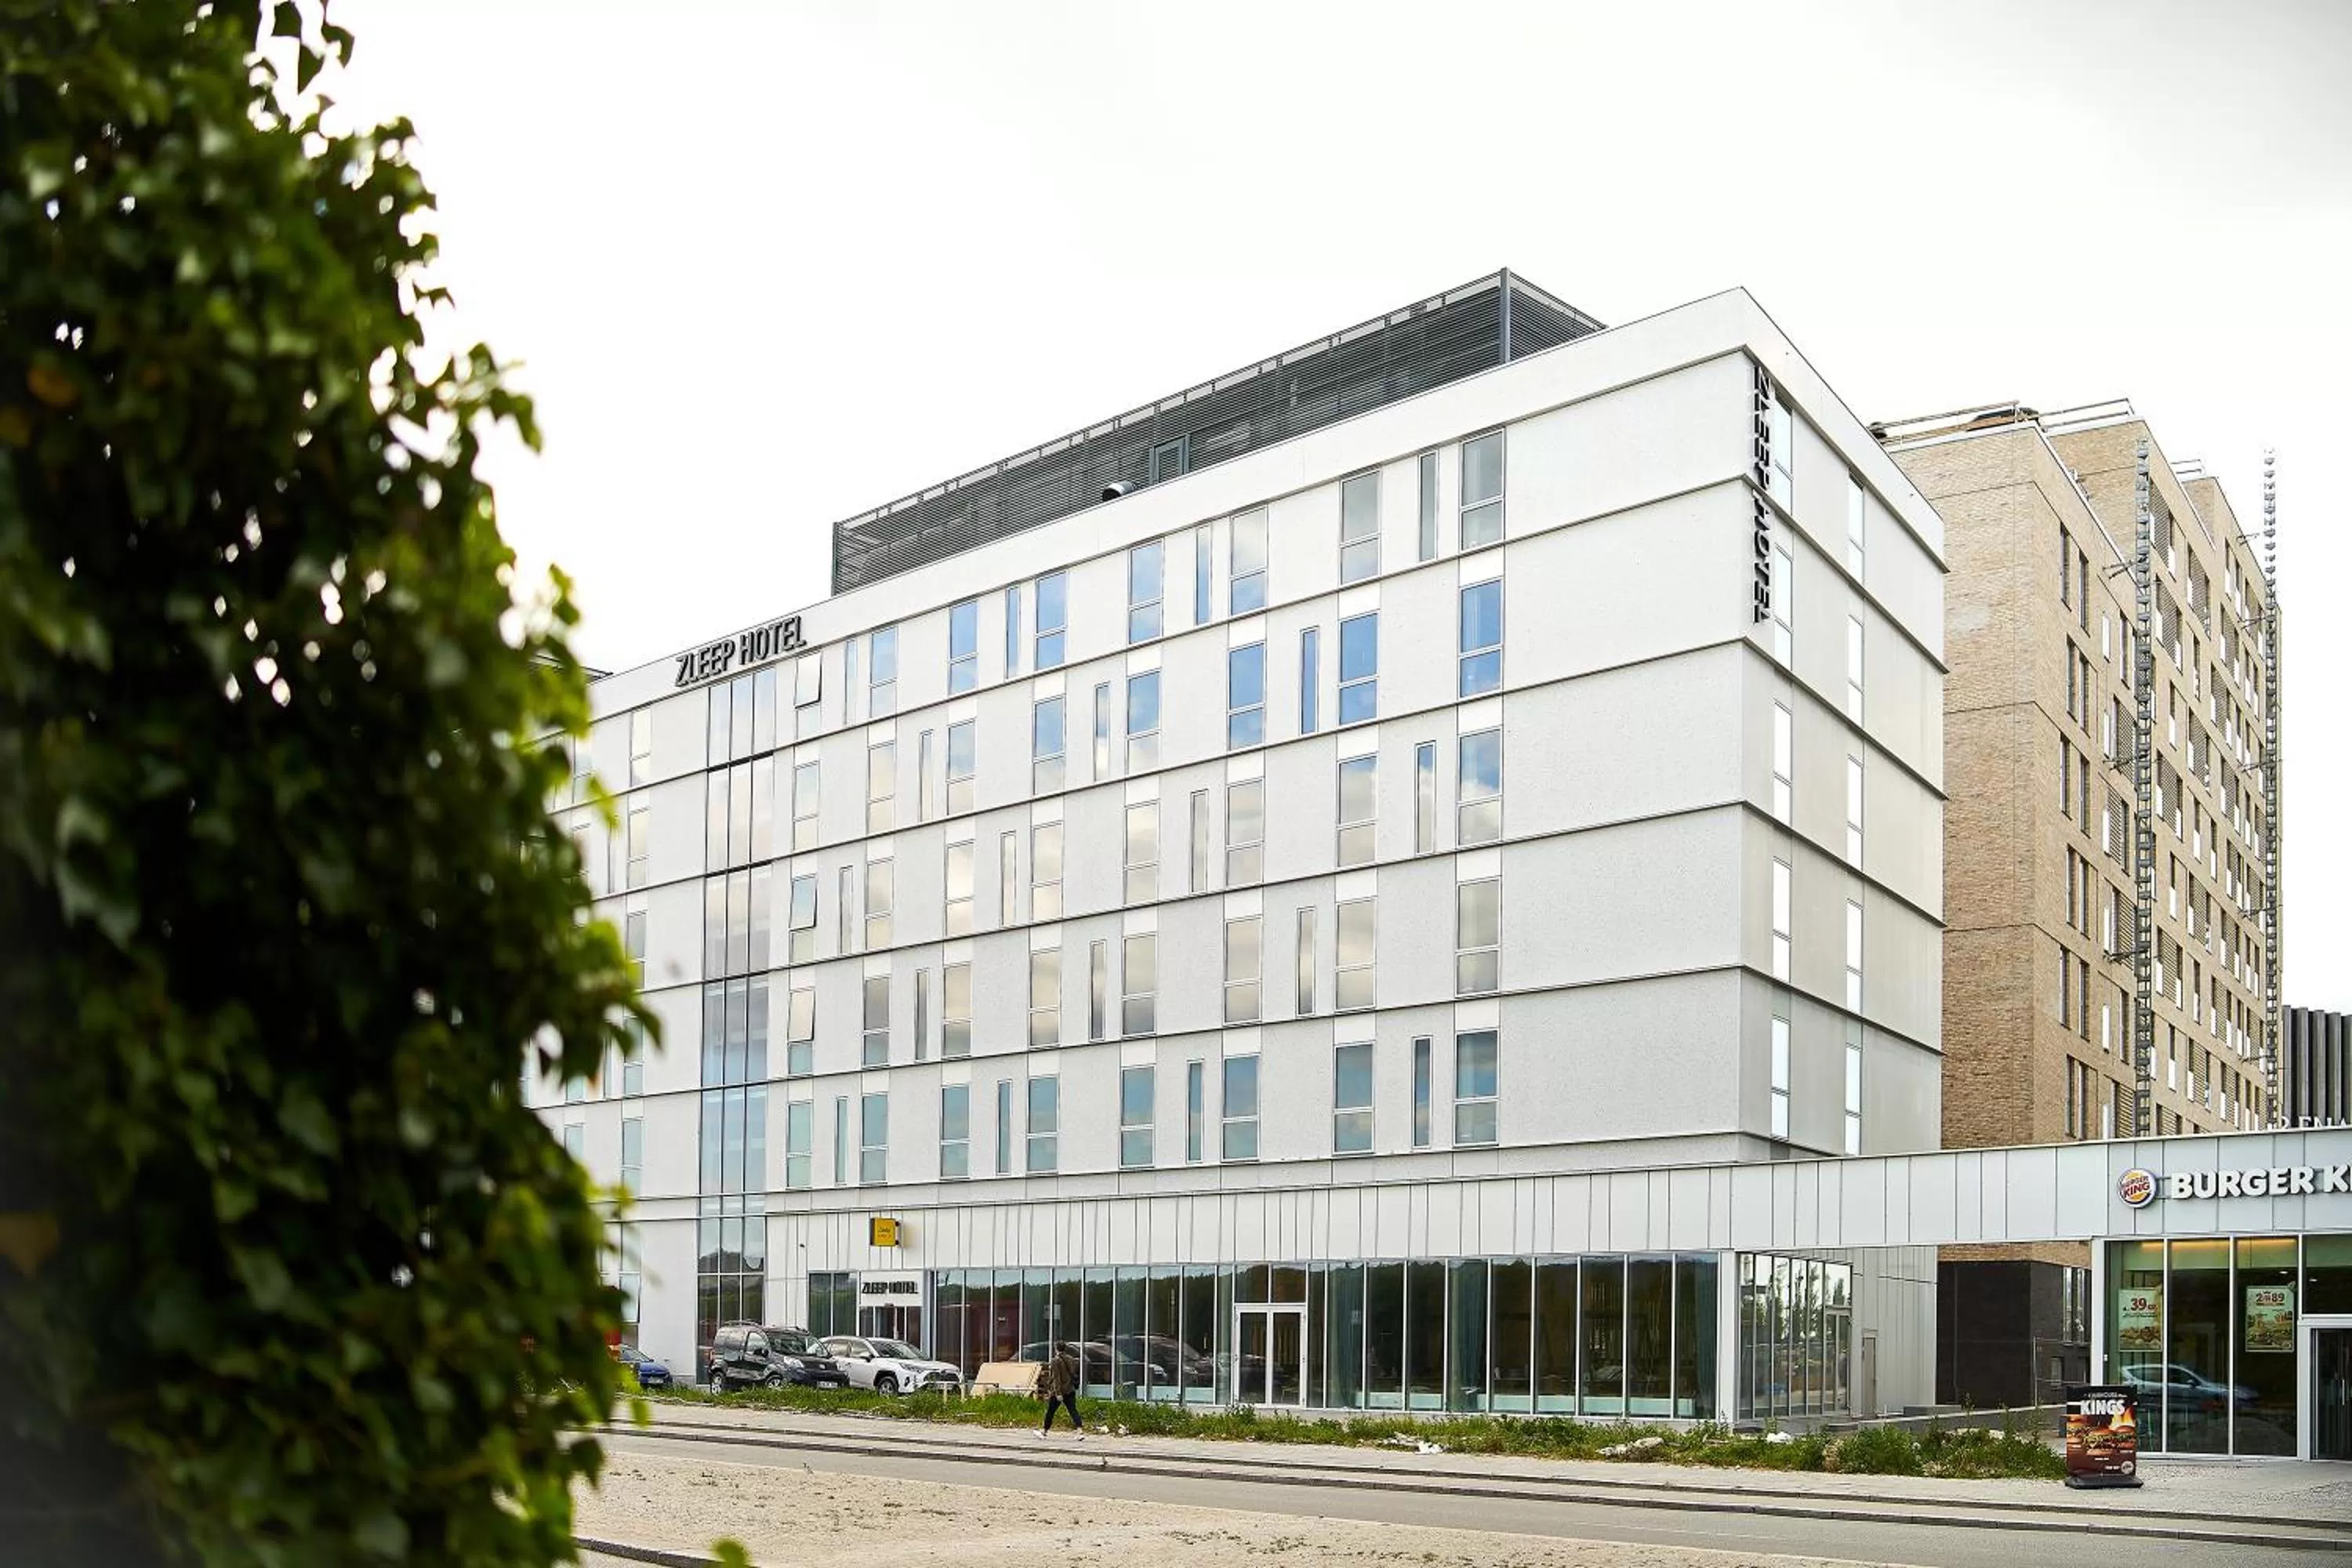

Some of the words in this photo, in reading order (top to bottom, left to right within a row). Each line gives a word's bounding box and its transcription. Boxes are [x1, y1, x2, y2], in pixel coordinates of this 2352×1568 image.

[1754, 366, 1771, 492] ZLEEP
[1753, 492, 1772, 624] HOTEL
[674, 639, 736, 687] ZLEEP
[739, 615, 808, 666] HOTEL
[2123, 1182, 2151, 1198] KING
[2170, 1167, 2315, 1199] BURGER
[2323, 1163, 2352, 1193] K
[2130, 1298, 2147, 1312] 39
[2080, 1399, 2125, 1415] KINGS
